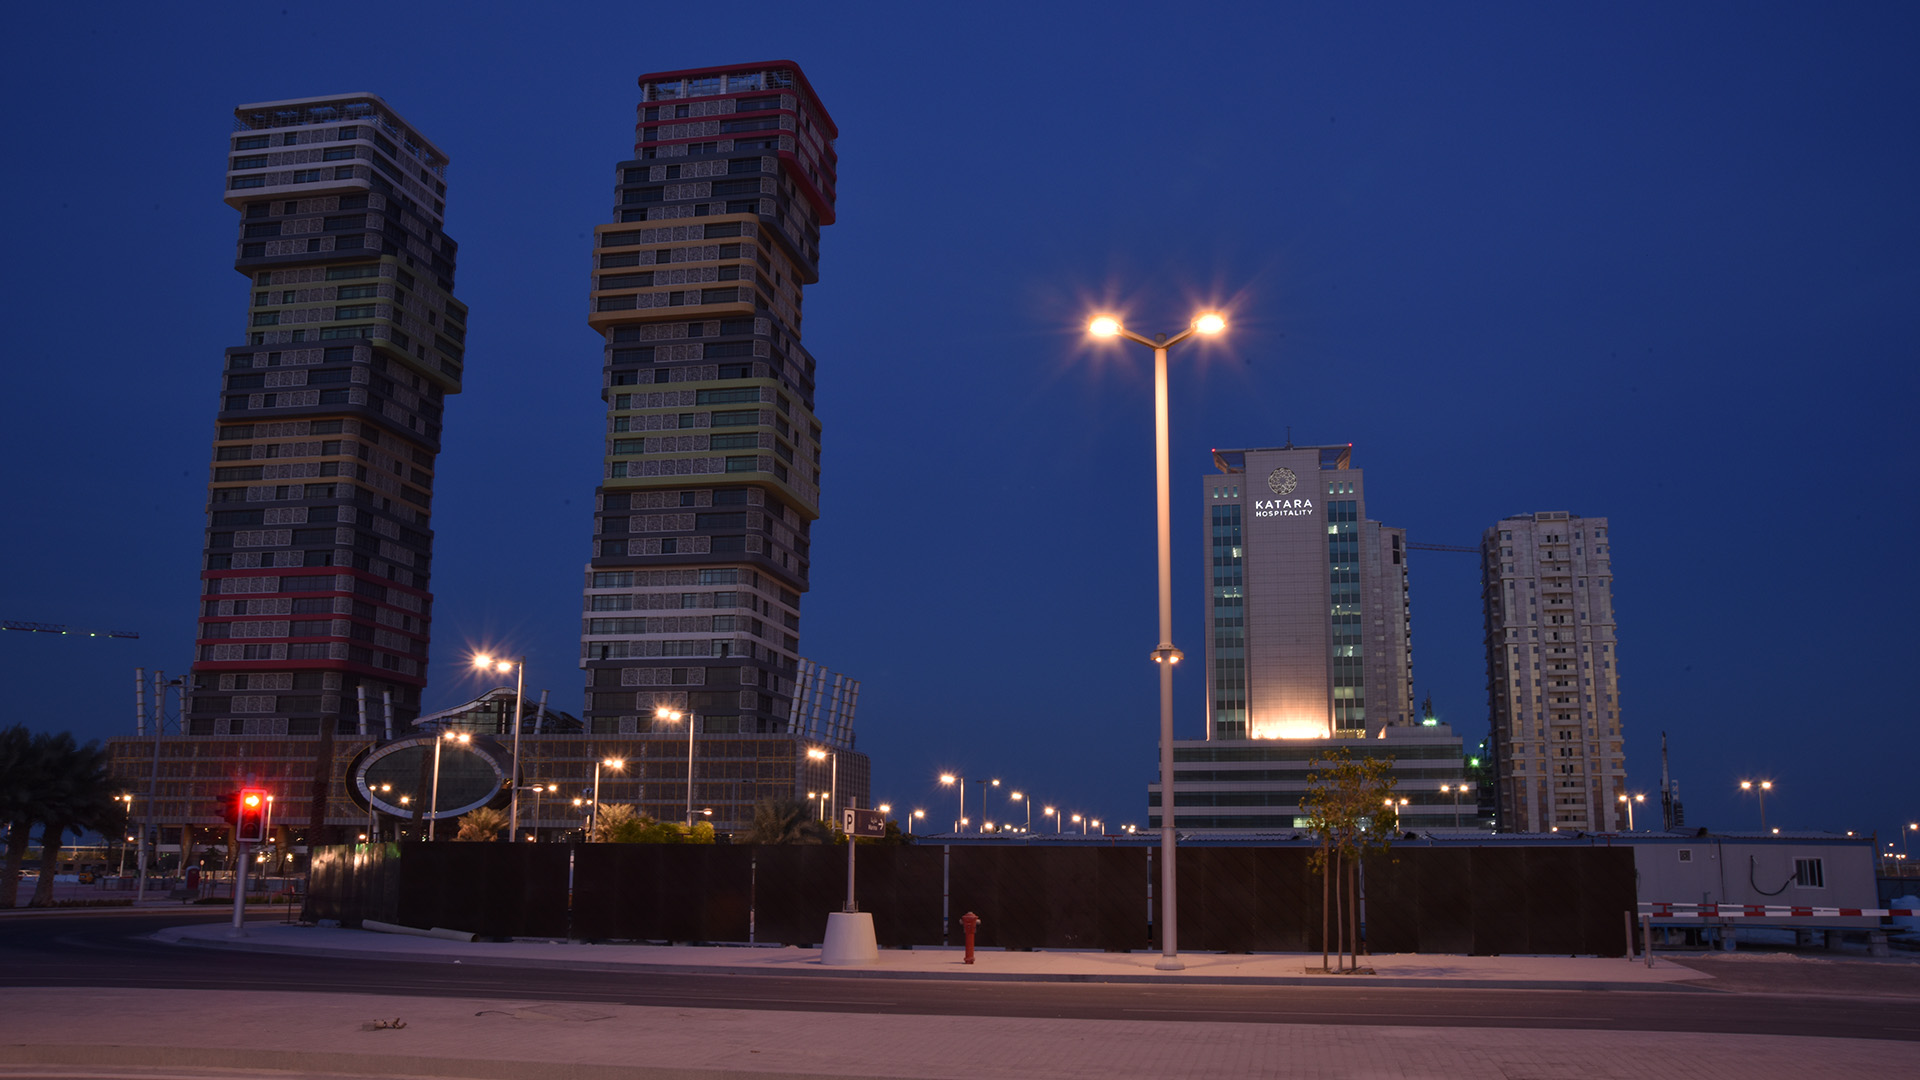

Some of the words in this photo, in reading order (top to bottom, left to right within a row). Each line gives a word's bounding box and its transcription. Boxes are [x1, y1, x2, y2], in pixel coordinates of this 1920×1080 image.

[1255, 499, 1313, 509] KATARA
[1255, 509, 1313, 517] HOSPITALITY
[847, 814, 853, 830] P
